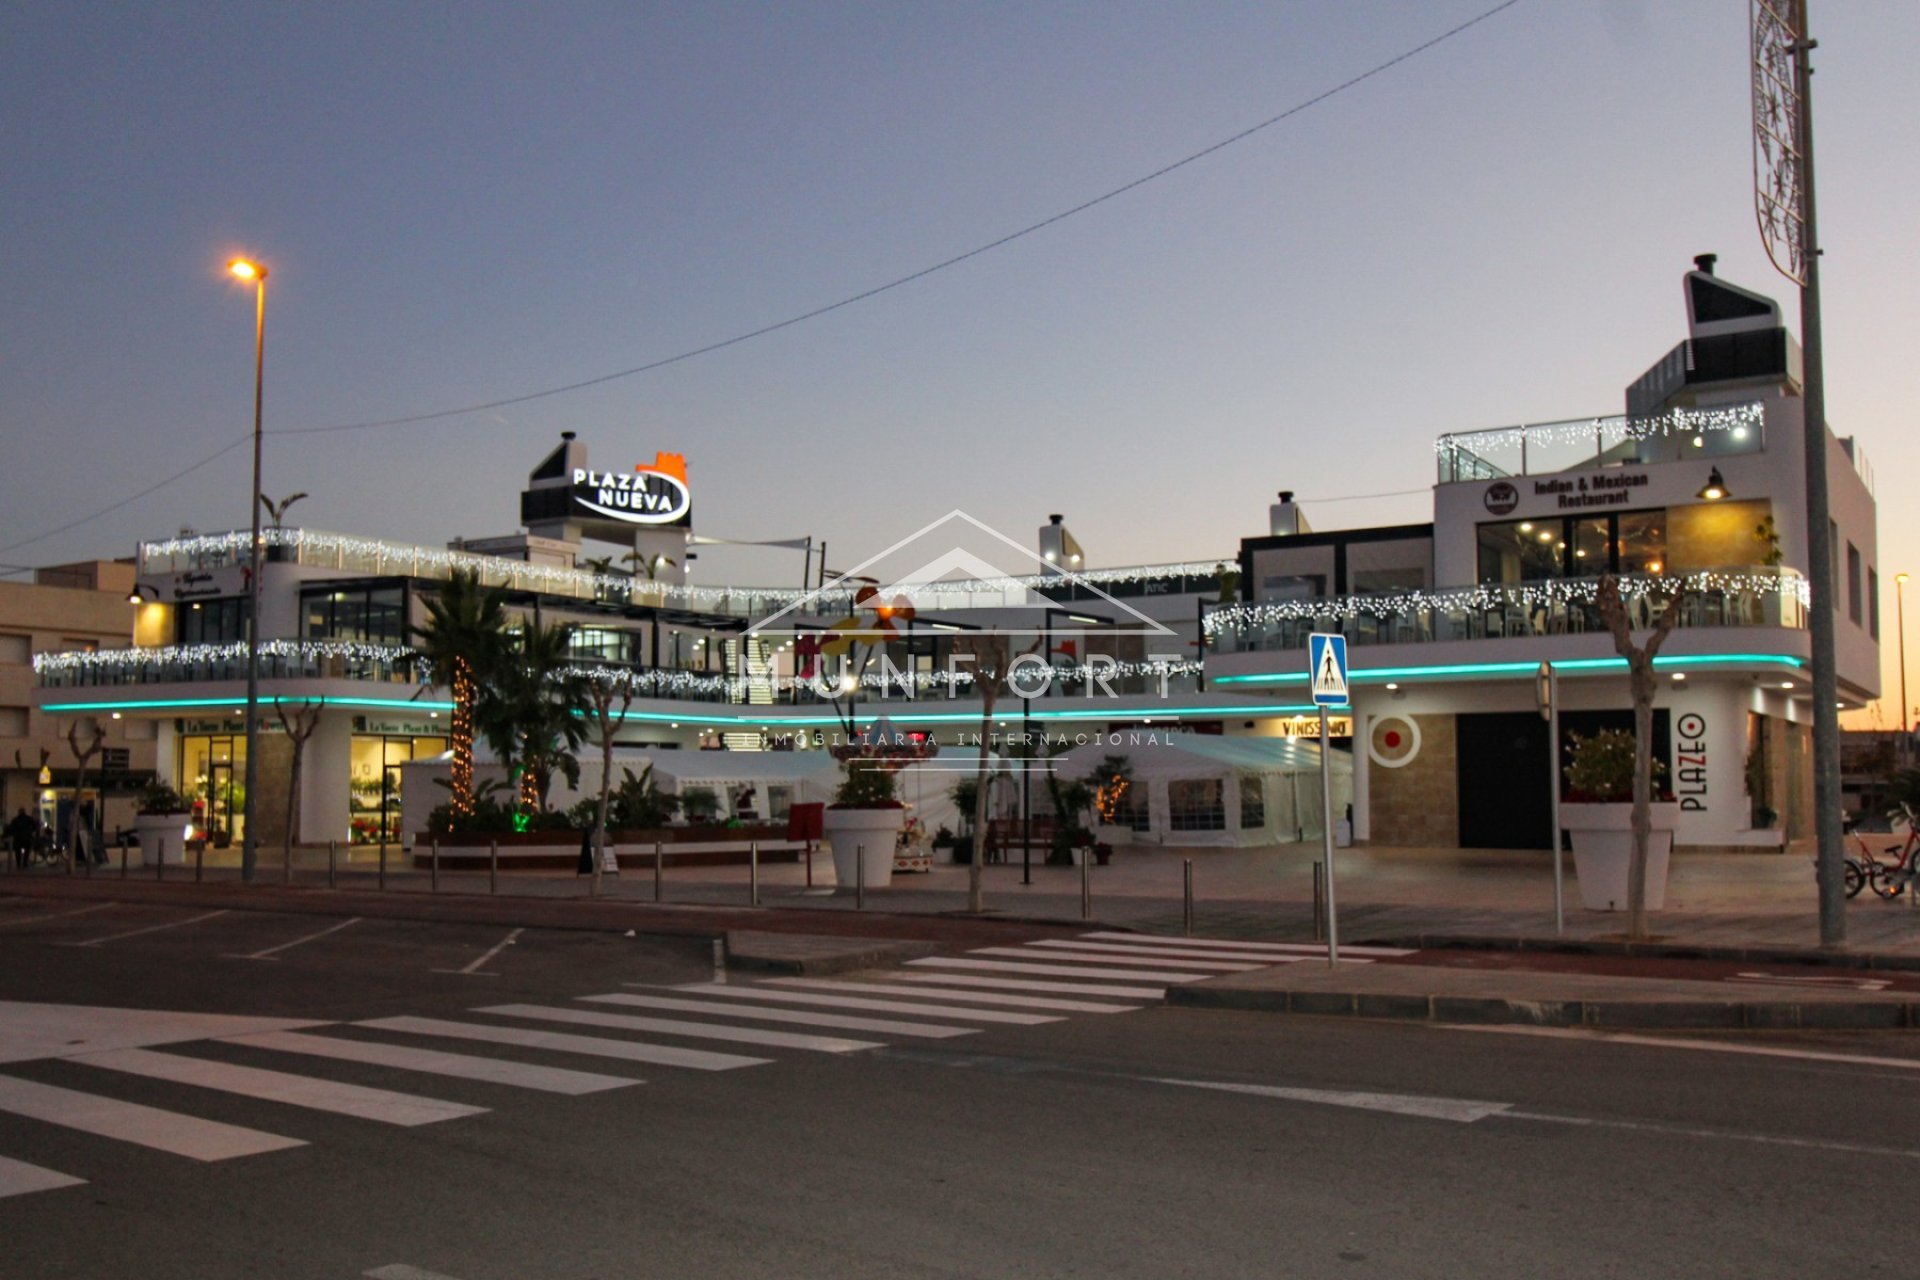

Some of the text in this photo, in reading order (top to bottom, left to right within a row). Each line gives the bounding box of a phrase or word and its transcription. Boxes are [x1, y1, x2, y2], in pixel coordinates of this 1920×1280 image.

[573, 468, 647, 492] PLAZA
[1534, 473, 1648, 495] Indian & Mexican
[598, 489, 673, 511] NUEVA
[1557, 490, 1629, 509] Restaurant
[1282, 721, 1347, 736] VINISSMO
[1677, 713, 1708, 812] PLAZEO
